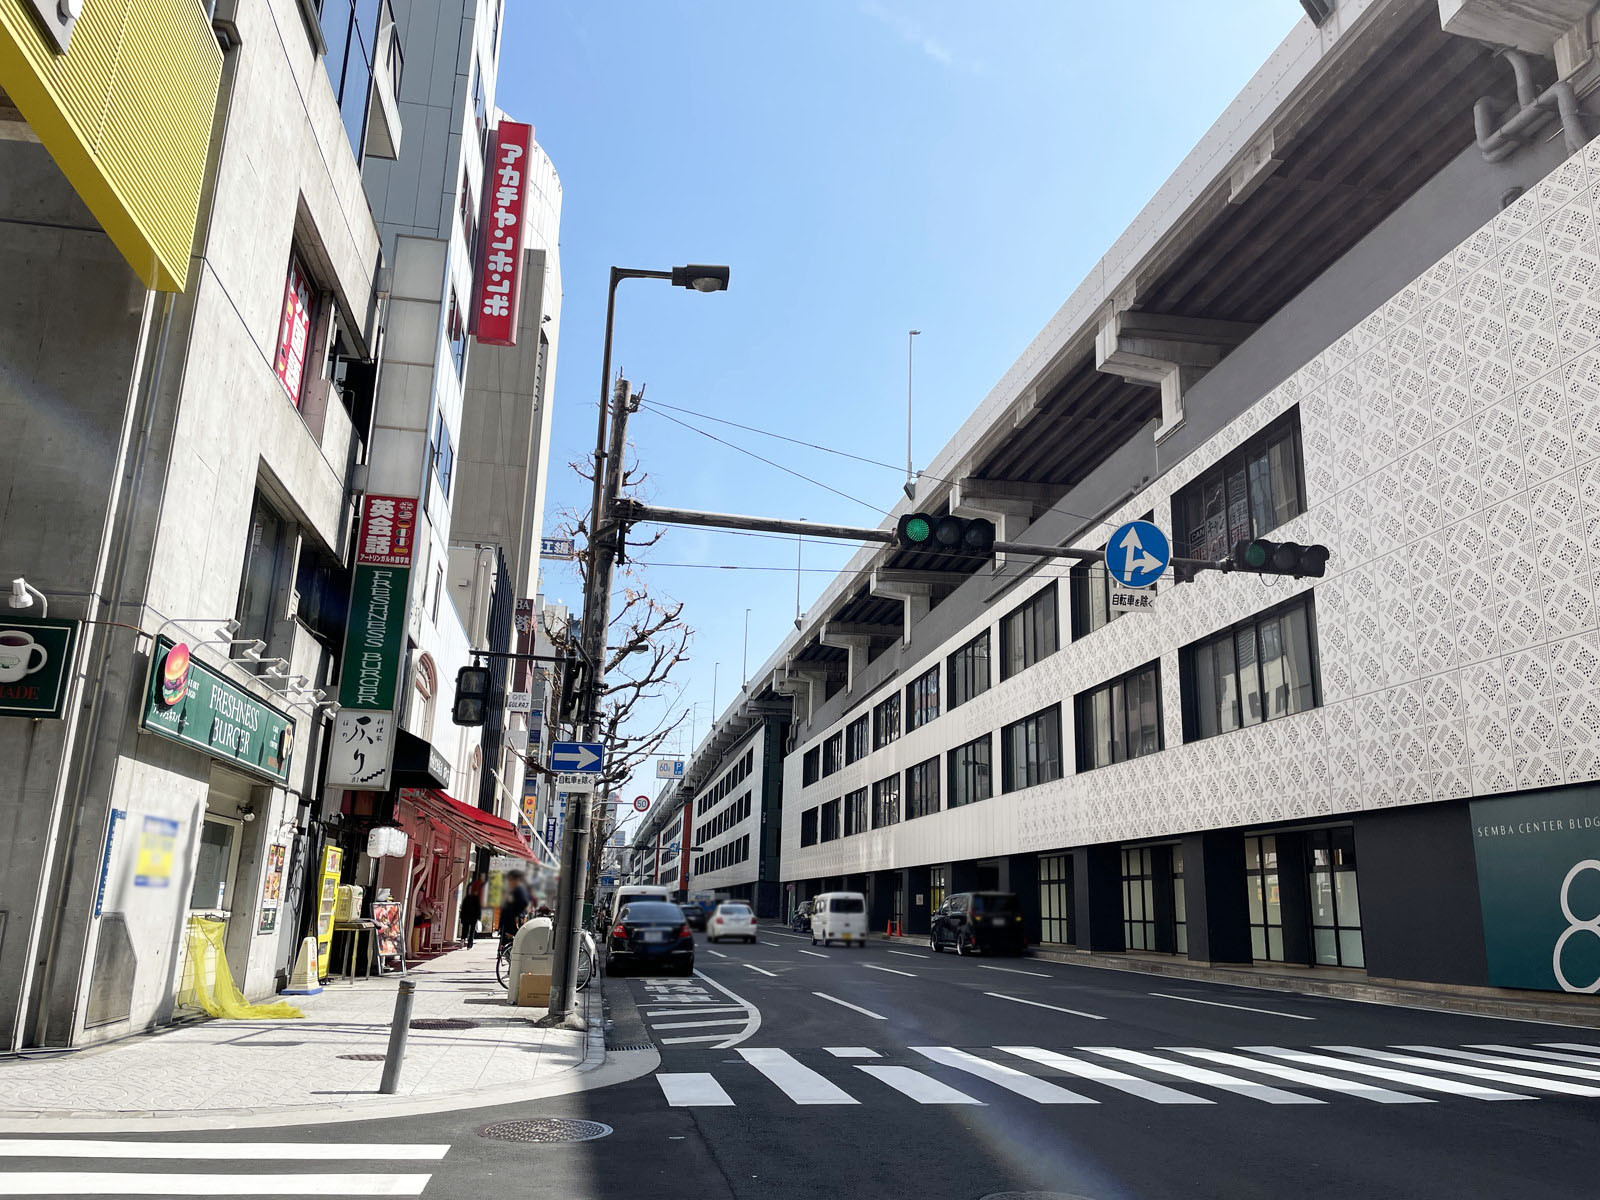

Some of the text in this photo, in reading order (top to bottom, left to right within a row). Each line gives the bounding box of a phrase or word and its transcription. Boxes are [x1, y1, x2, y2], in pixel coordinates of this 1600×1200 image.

[483, 143, 523, 317] アカチャンホンポ
[365, 499, 395, 554] 英会話
[1112, 593, 1154, 607] 自転車を除く
[356, 570, 393, 705] FRESHNESS BURGER
[209, 684, 260, 732] FRESHNESS
[212, 716, 251, 756] BURGER
[558, 775, 593, 785] 自転車を除く
[637, 800, 647, 808] 50
[1477, 816, 1600, 837] SEMBA CENTER BLDG
[1553, 859, 1600, 994] 8
